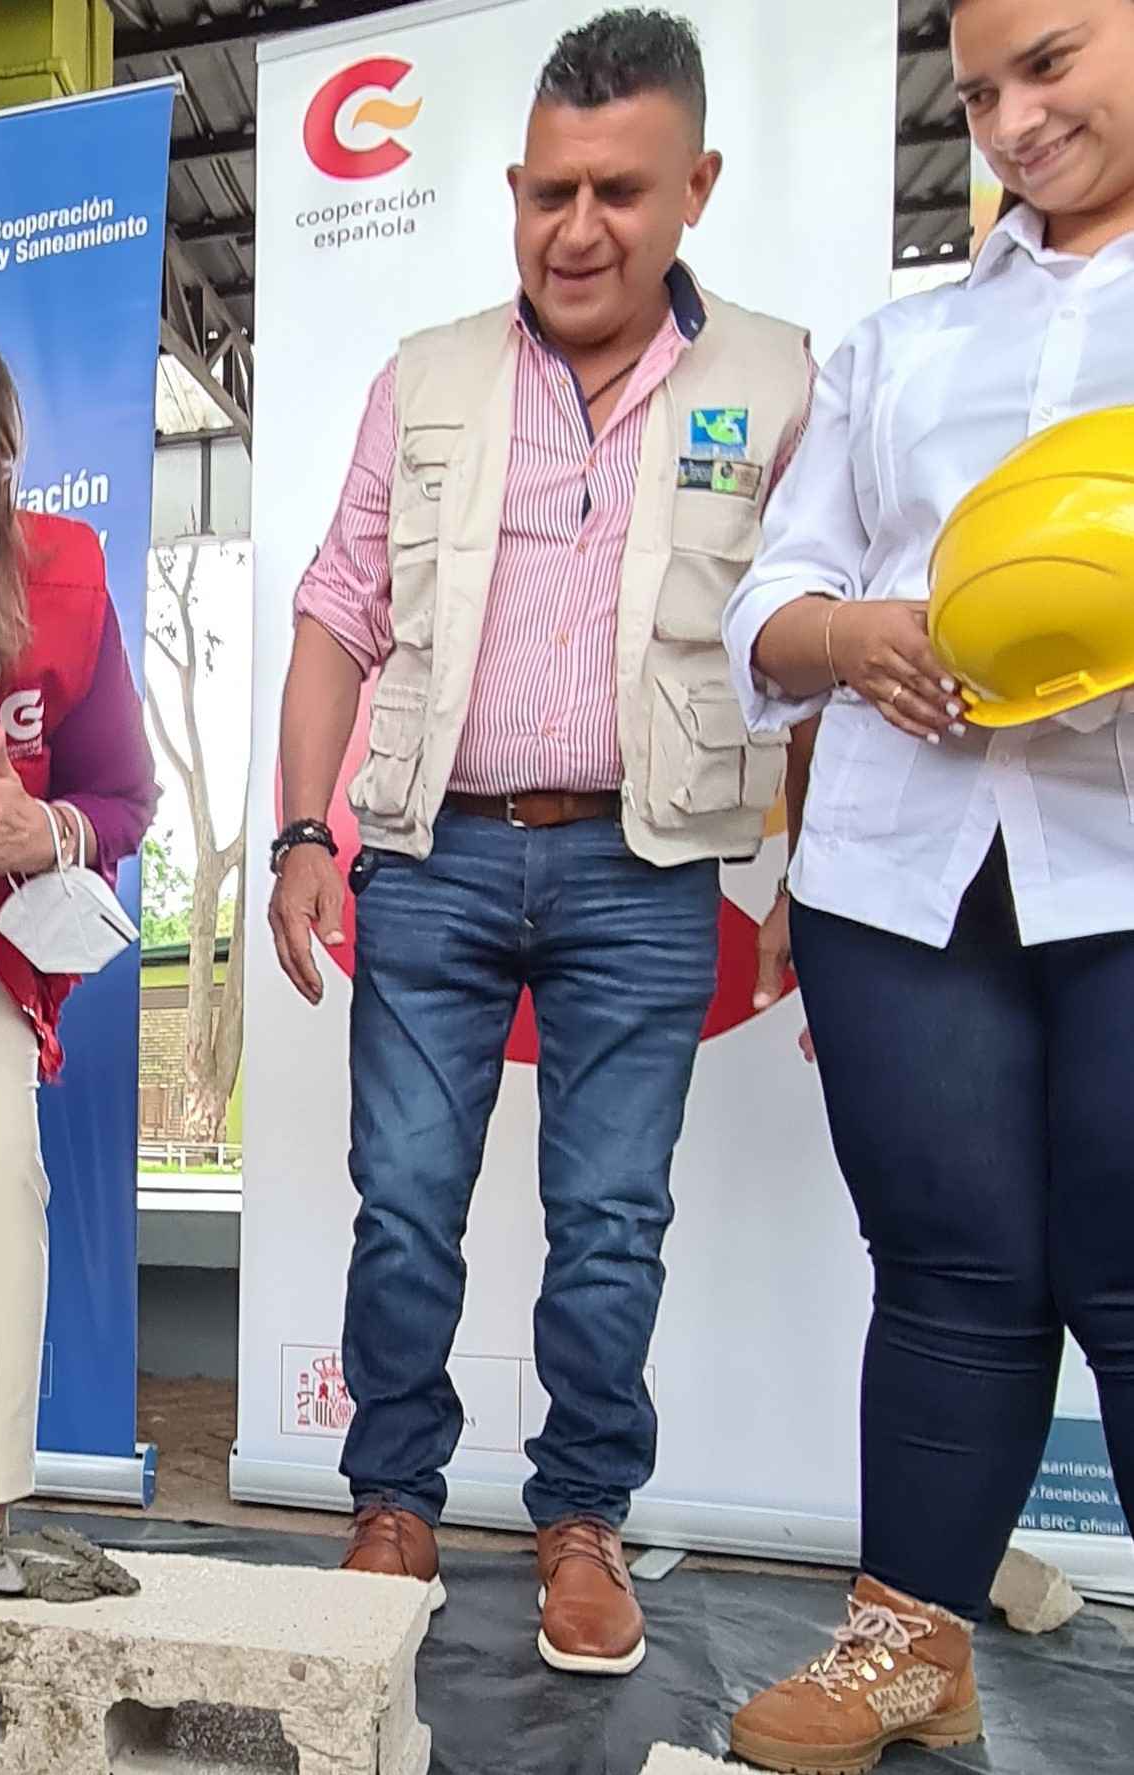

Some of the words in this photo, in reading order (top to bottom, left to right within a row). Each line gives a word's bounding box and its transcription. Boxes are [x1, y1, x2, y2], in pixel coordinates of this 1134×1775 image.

[295, 187, 436, 228] cooperación
[15, 215, 148, 264] Saneamiento
[314, 215, 416, 248] española
[16, 468, 108, 514] ración
